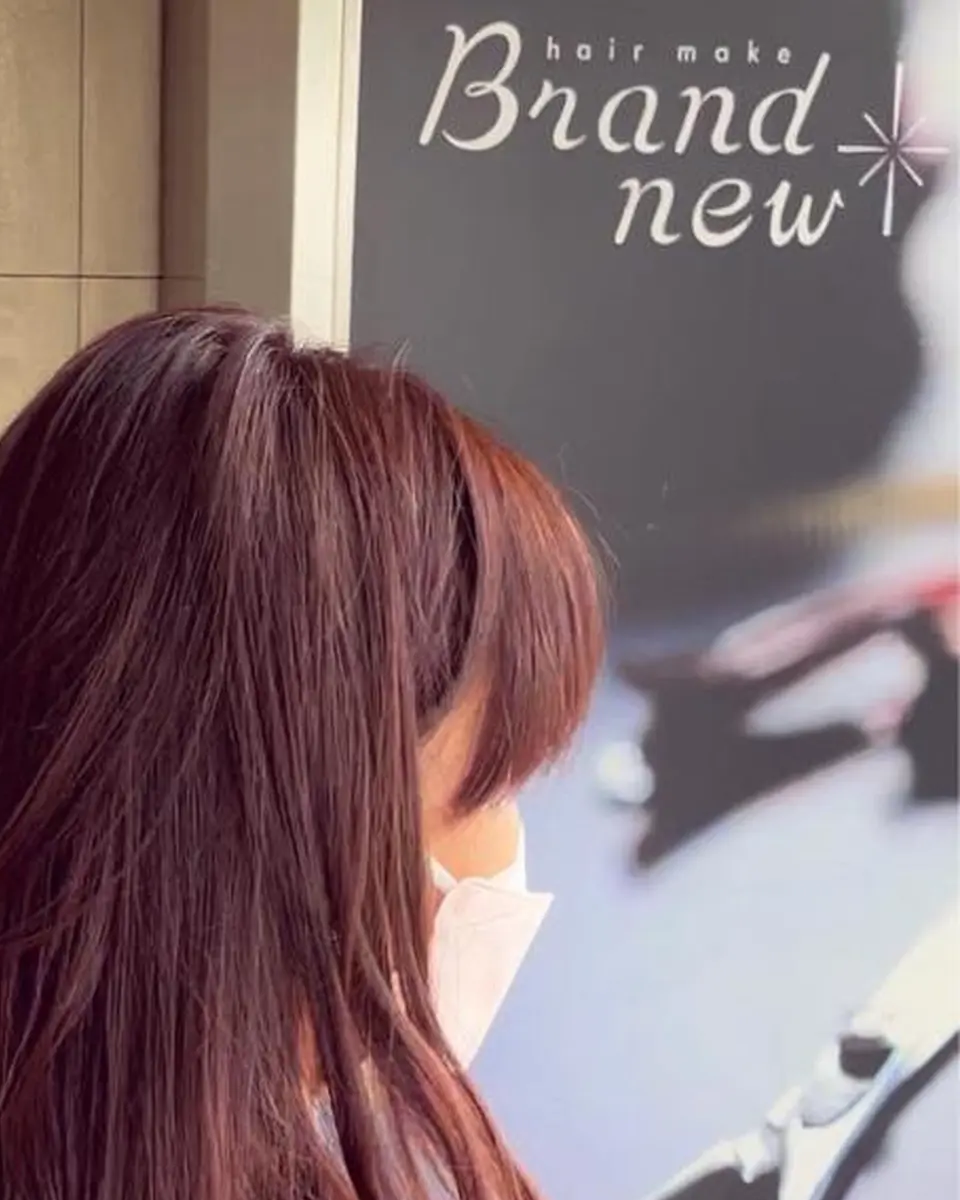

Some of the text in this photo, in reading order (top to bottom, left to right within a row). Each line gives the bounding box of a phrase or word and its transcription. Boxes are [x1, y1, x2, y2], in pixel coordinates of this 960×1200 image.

[546, 36, 793, 65] hair make
[418, 20, 831, 156] Brand
[613, 176, 845, 248] new
